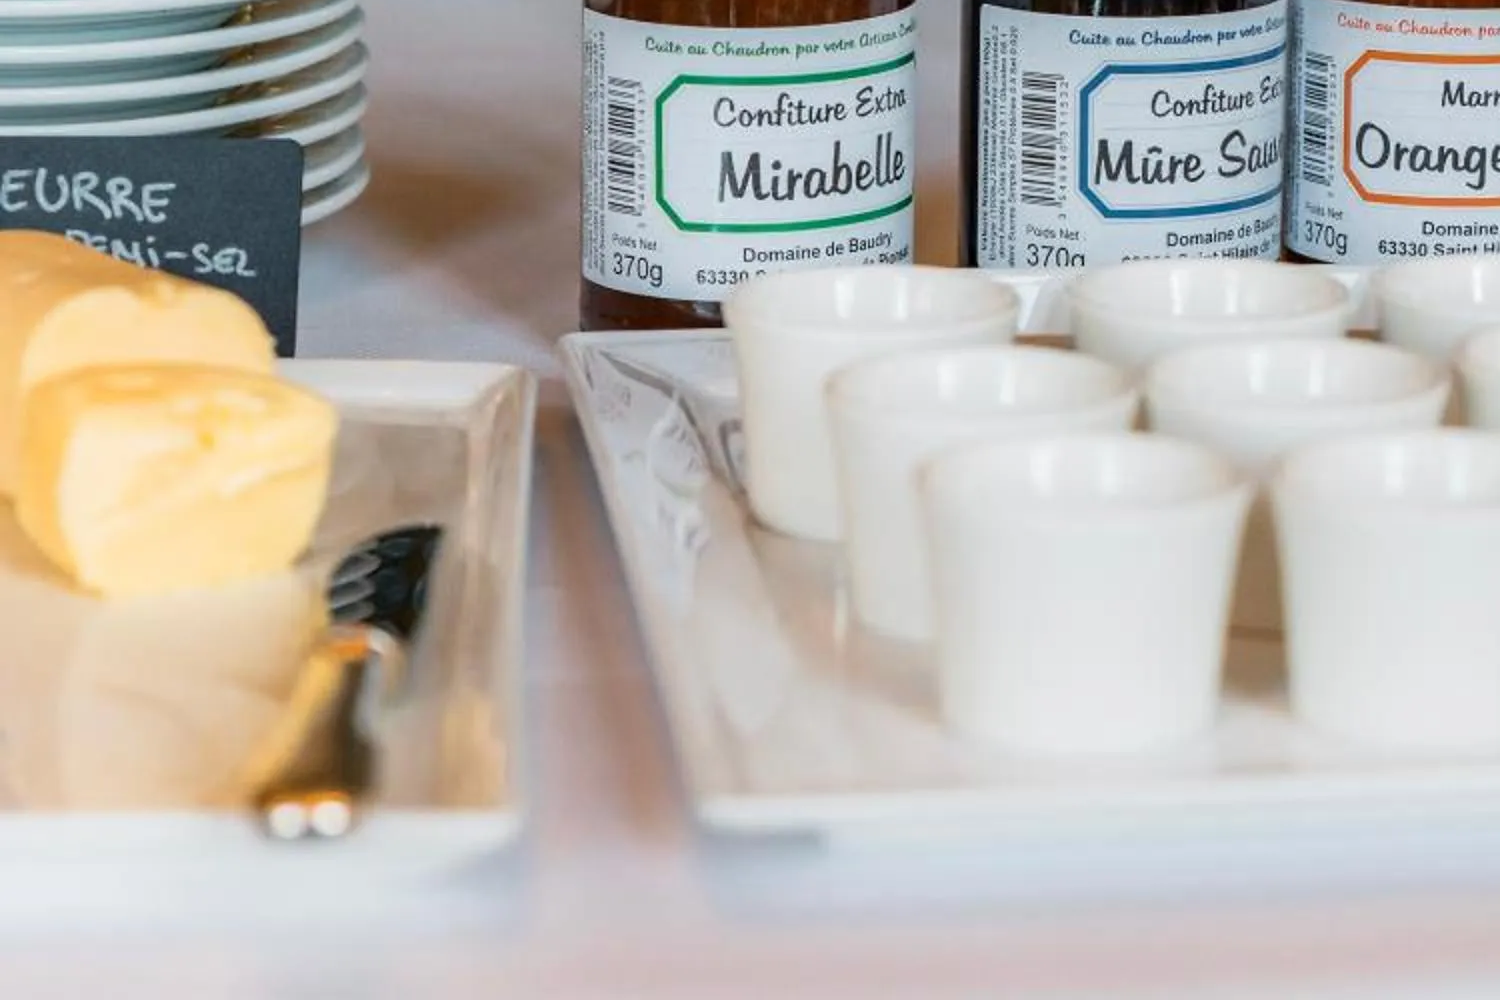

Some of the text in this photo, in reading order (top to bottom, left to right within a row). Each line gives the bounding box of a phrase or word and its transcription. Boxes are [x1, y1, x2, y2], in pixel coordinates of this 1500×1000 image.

[1069, 28, 1110, 46] Cuite
[1115, 33, 1137, 46] au
[1141, 27, 1213, 46] Chaudron
[1337, 11, 1372, 31] Cuite
[1375, 21, 1393, 33] au
[1398, 18, 1473, 36] Chaudron
[644, 36, 683, 54] Cuite
[687, 44, 707, 56] au
[711, 39, 790, 57] Chaudron
[795, 43, 819, 59] par
[823, 39, 855, 53] votre
[713, 85, 907, 128] Confiture Extra
[1151, 83, 1254, 119] Confiture
[717, 131, 906, 203] Mirabelle
[1094, 137, 1205, 186] Mûre
[1166, 227, 1235, 248] Domaine
[1237, 223, 1253, 239] de
[1304, 219, 1347, 257] 370g
[1422, 220, 1499, 237] Domaine
[743, 230, 894, 263] Domaine de Baudry
[1378, 239, 1428, 257] 63330
[613, 252, 663, 288] 370g
